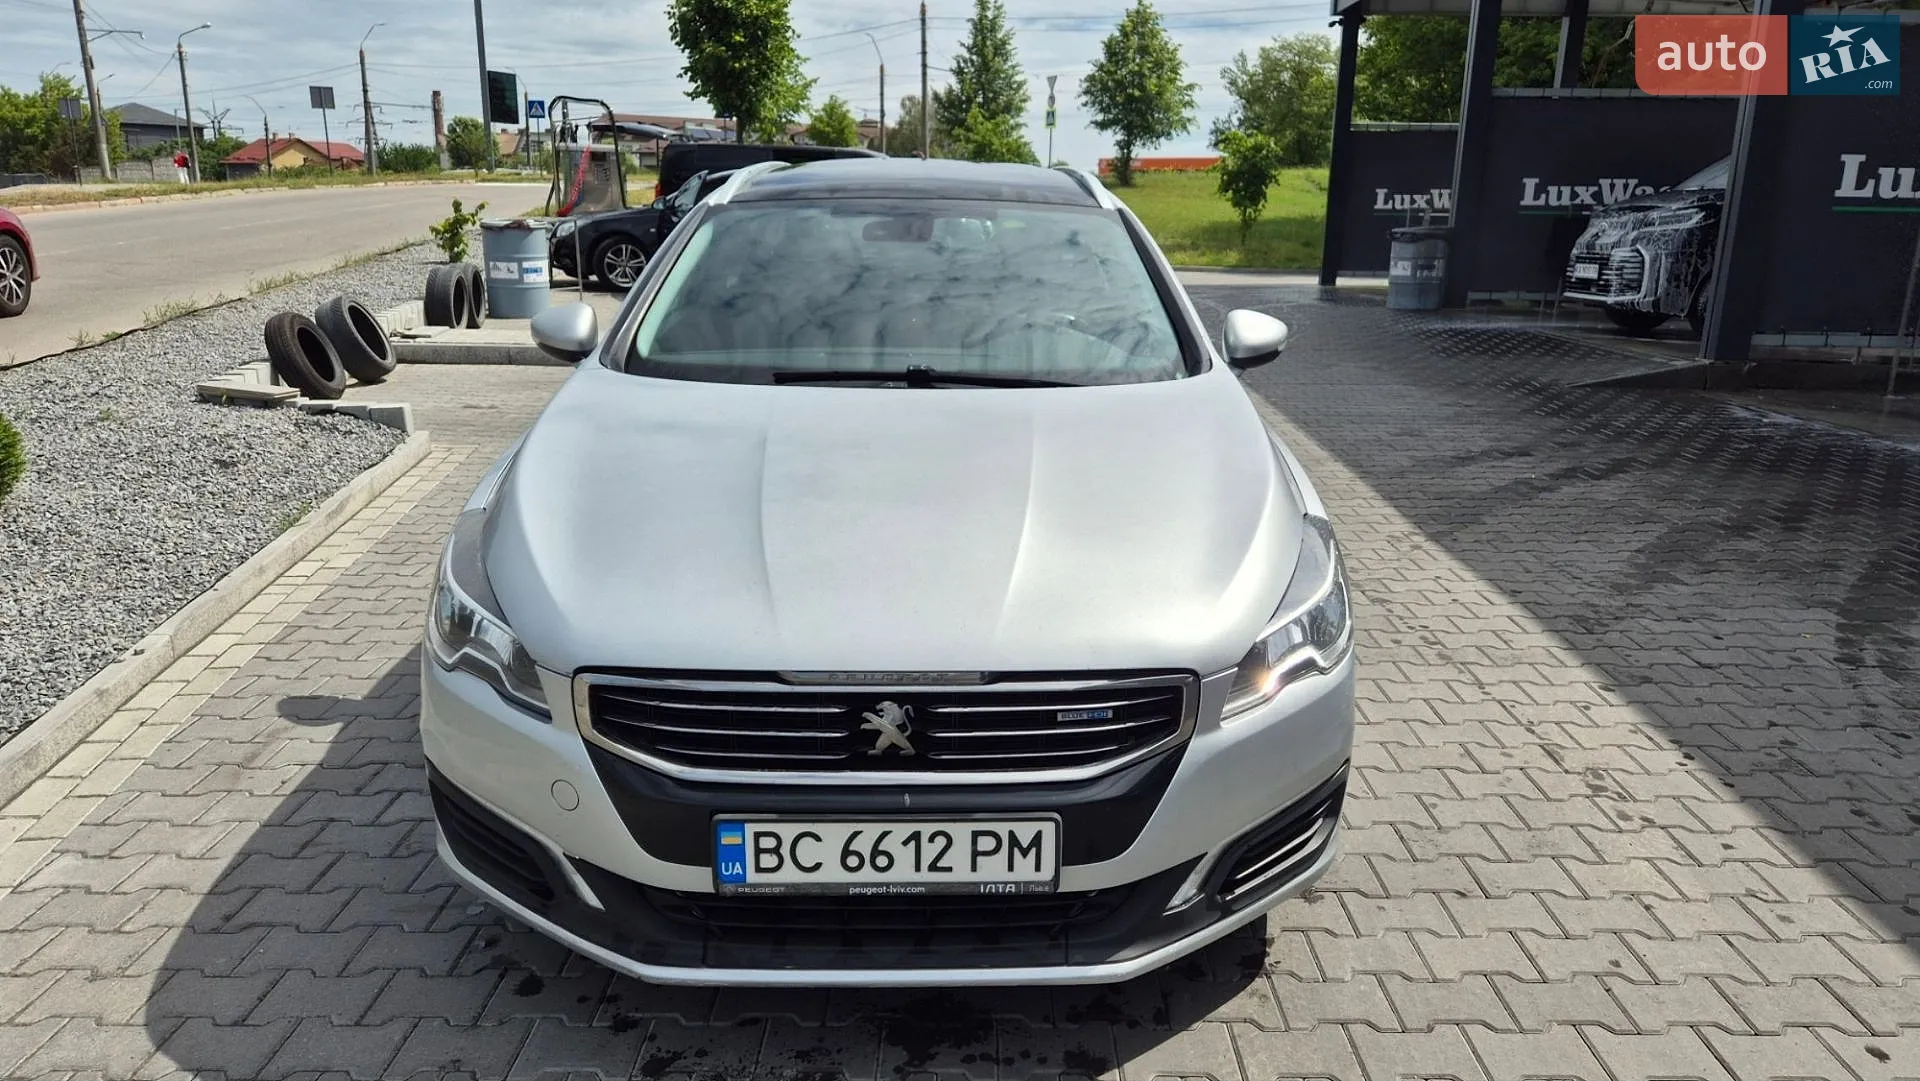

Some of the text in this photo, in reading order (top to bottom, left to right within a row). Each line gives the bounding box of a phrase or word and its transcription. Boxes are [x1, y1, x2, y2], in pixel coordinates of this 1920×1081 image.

[1834, 153, 1920, 200] Lu
[1519, 177, 1671, 207] LuxW
[753, 829, 1044, 874] BC 6612 PM
[721, 862, 744, 876] UA
[849, 884, 926, 896] peugeot-lviv.com
